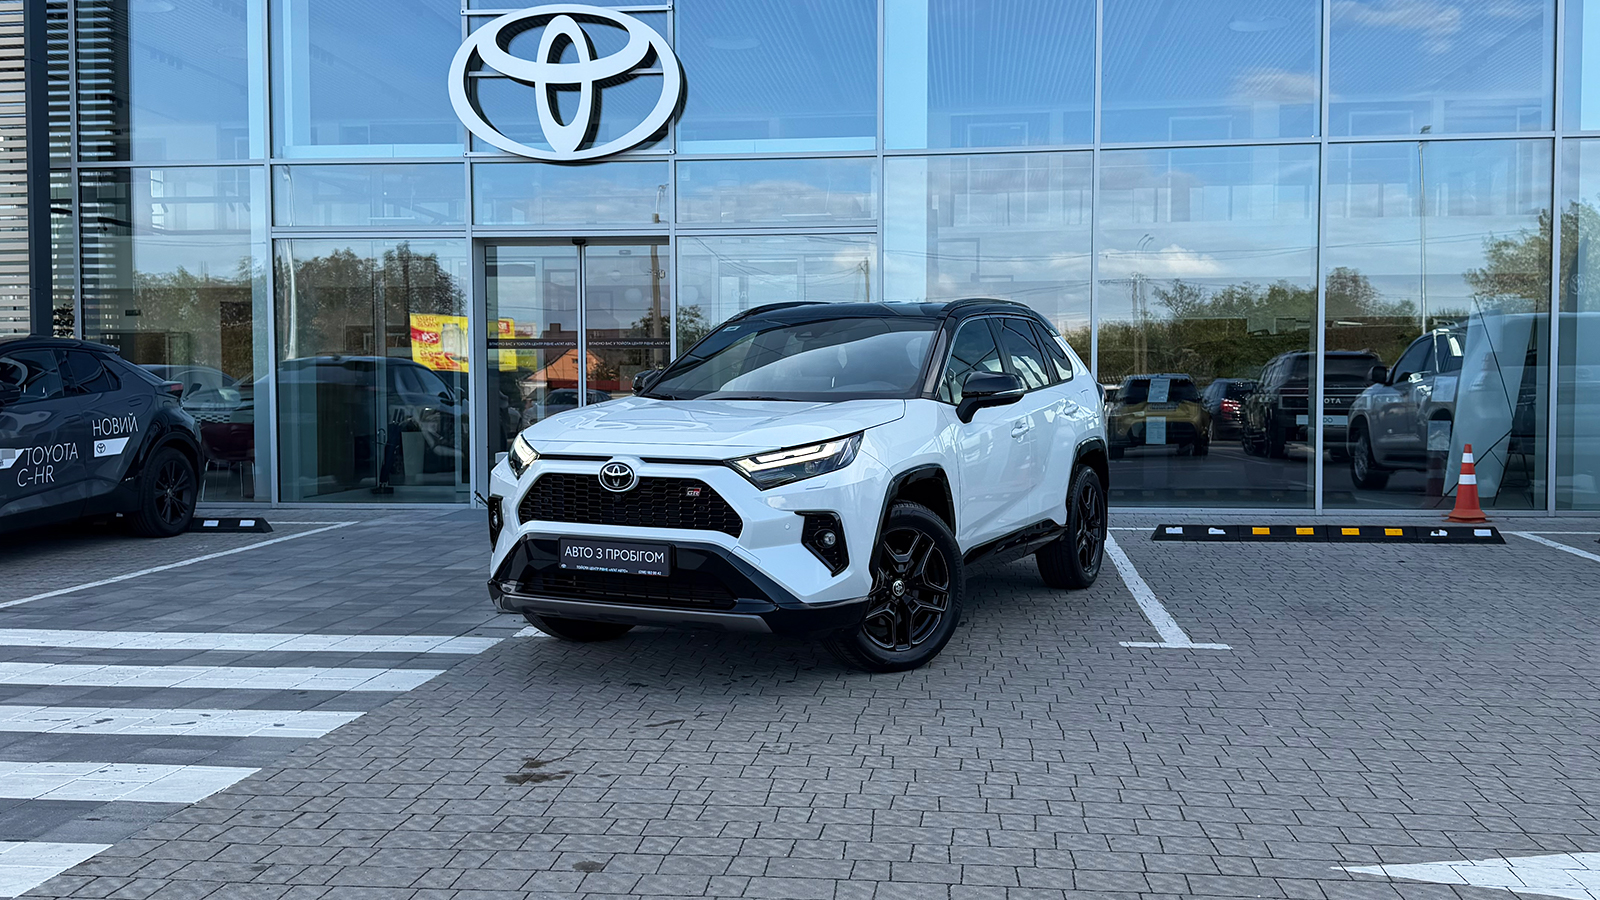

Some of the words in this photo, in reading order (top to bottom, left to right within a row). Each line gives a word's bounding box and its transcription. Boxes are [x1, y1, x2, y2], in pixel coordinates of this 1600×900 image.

[92, 412, 139, 437] НОВИЙ
[25, 442, 79, 466] TOYOTA
[17, 464, 55, 488] C-HR
[564, 546, 593, 558] АВТО
[606, 548, 664, 564] ПРОБІГОМ
